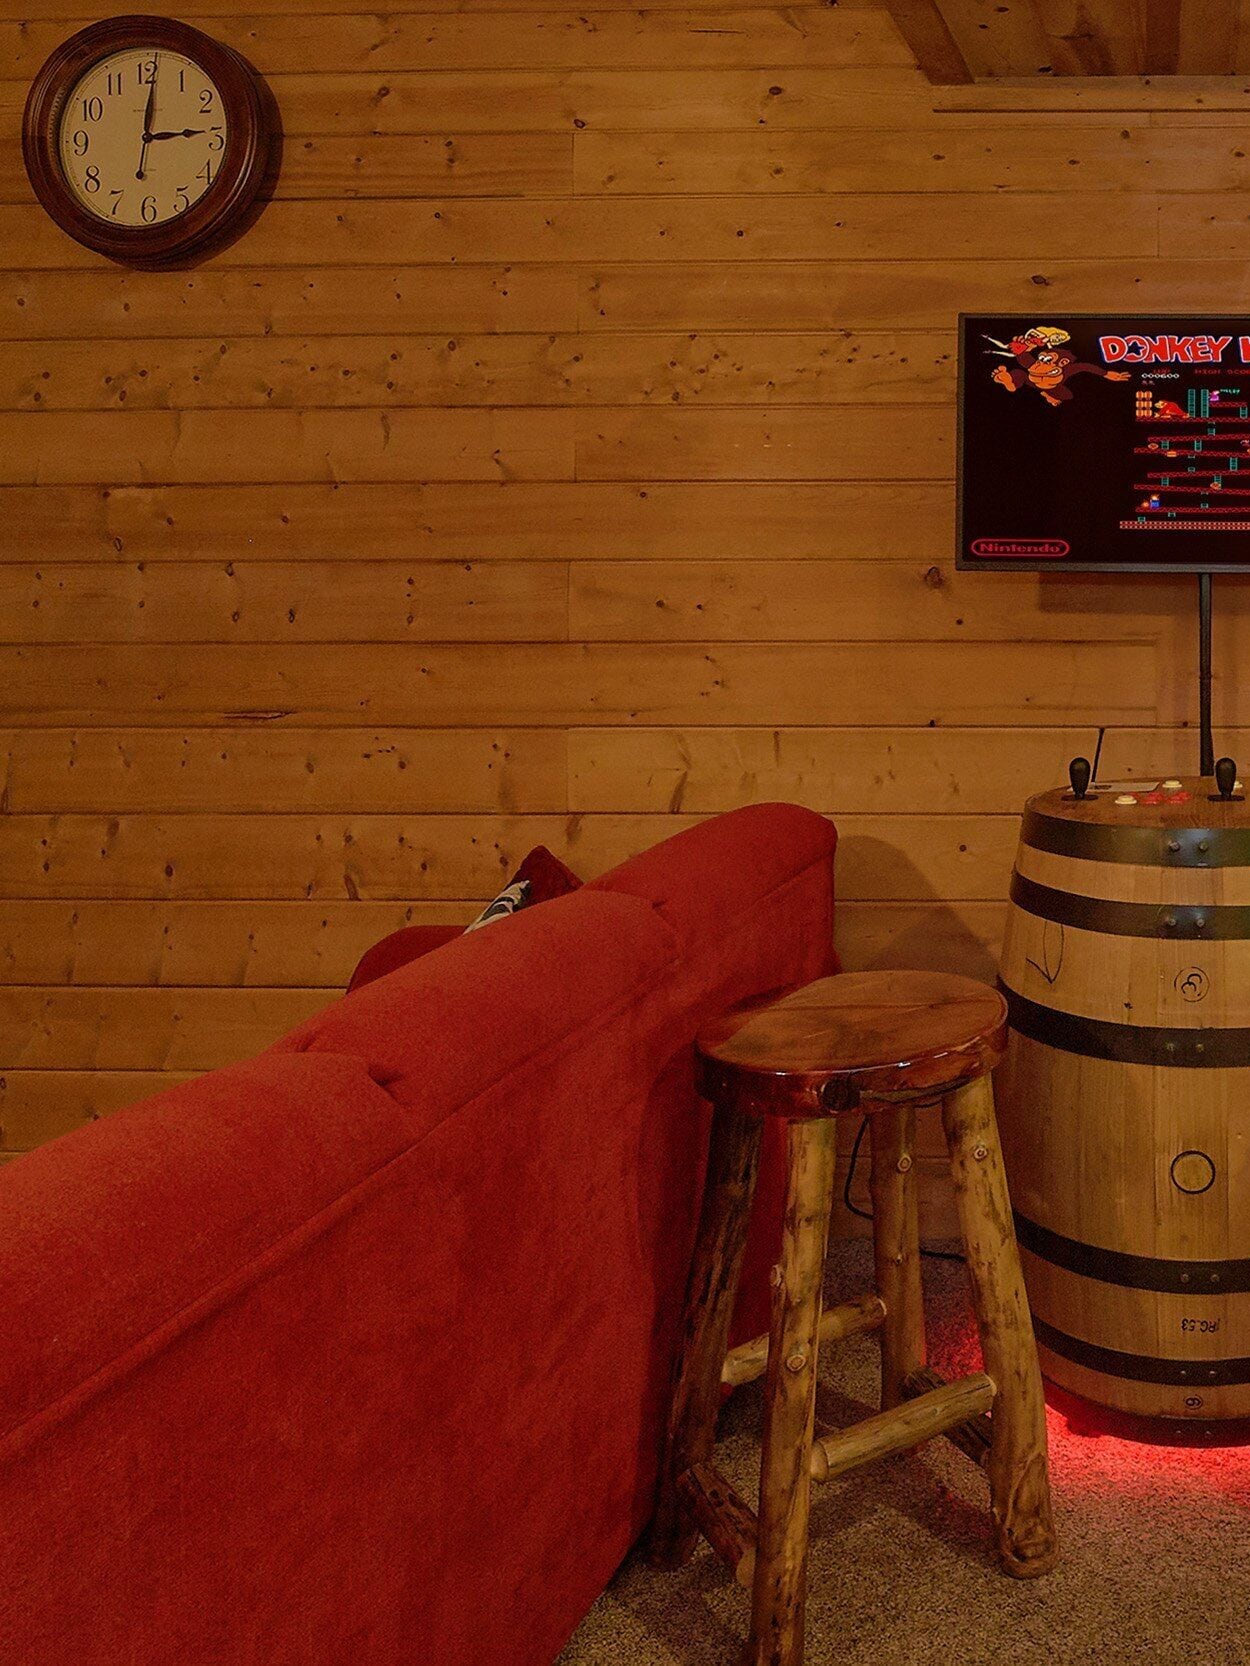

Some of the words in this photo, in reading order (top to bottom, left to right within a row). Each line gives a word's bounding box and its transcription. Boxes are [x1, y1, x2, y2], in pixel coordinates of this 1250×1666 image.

[107, 72, 122, 96] 11
[136, 61, 157, 85] 12
[178, 70, 186, 93] 1
[82, 97, 103, 122] 10
[199, 89, 213, 114] 2
[73, 130, 89, 156] 9
[208, 126, 224, 151] 3
[84, 165, 101, 194] 8
[196, 158, 214, 185] 4
[109, 189, 124, 216] 7
[141, 196, 157, 223] 6
[173, 186, 190, 213] 5
[1099, 335, 1232, 364] DONKEY
[980, 542, 1060, 553] Nintendo
